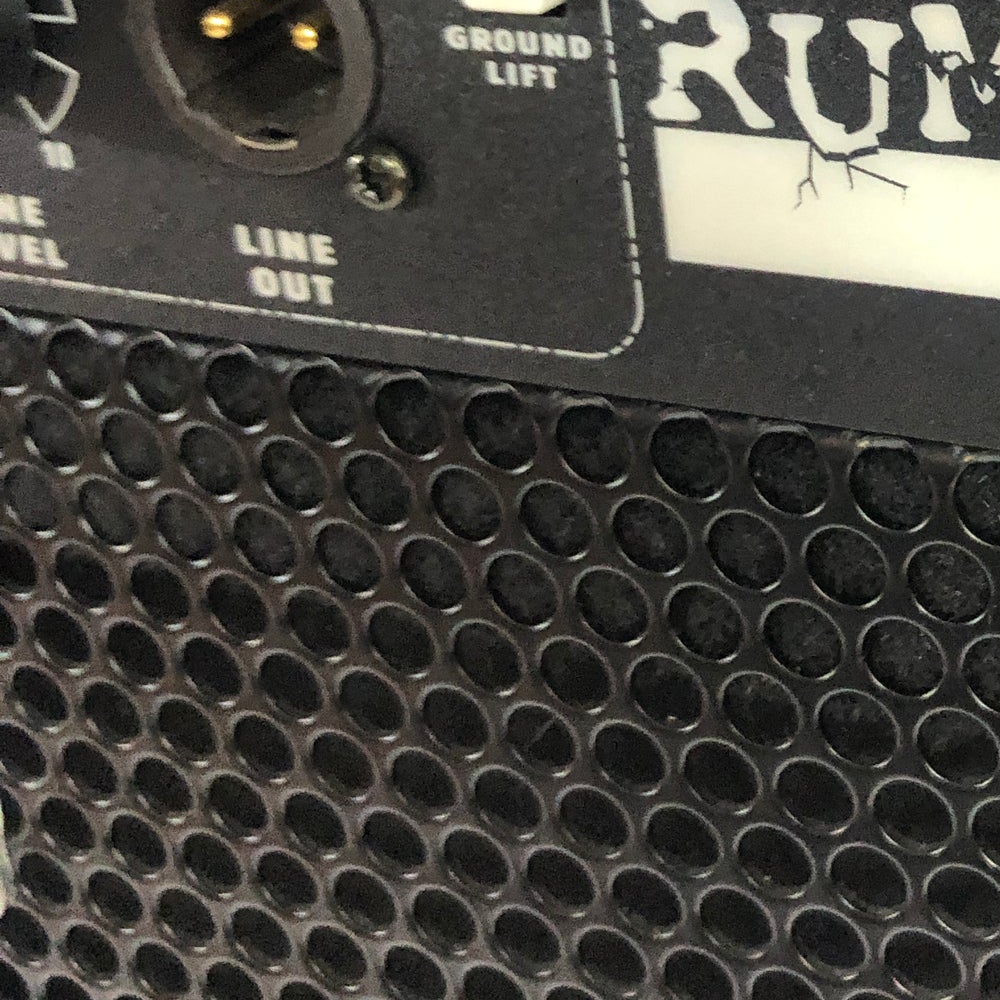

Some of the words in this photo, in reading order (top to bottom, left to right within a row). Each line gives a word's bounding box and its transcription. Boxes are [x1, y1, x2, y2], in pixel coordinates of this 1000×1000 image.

[442, 24, 593, 61] GROUND
[484, 60, 558, 91] LIFT
[232, 222, 339, 267] LINE
[247, 265, 335, 306] OUT
